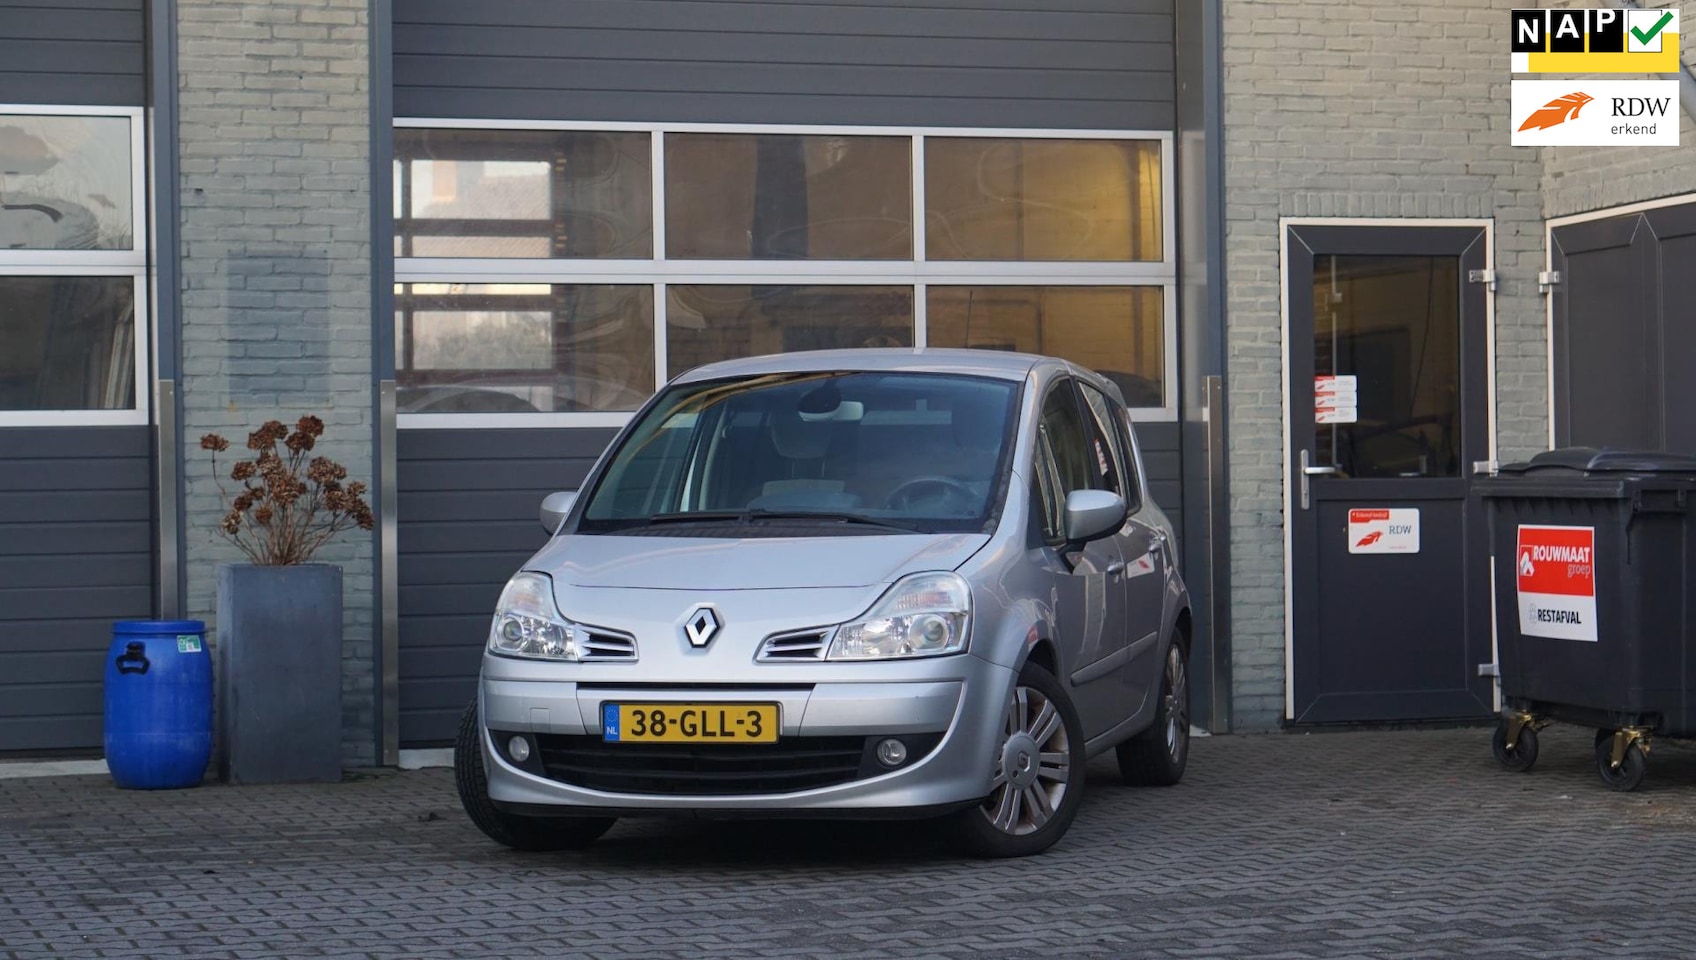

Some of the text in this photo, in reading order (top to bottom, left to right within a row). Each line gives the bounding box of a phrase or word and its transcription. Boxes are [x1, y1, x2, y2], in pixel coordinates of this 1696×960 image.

[1389, 525, 1411, 535] RDW
[1533, 545, 1590, 562] ROUWMAAT
[1567, 564, 1591, 578] groep
[1537, 608, 1582, 624] RESTAFVAL
[606, 710, 763, 737] NL 38-GLL-3
